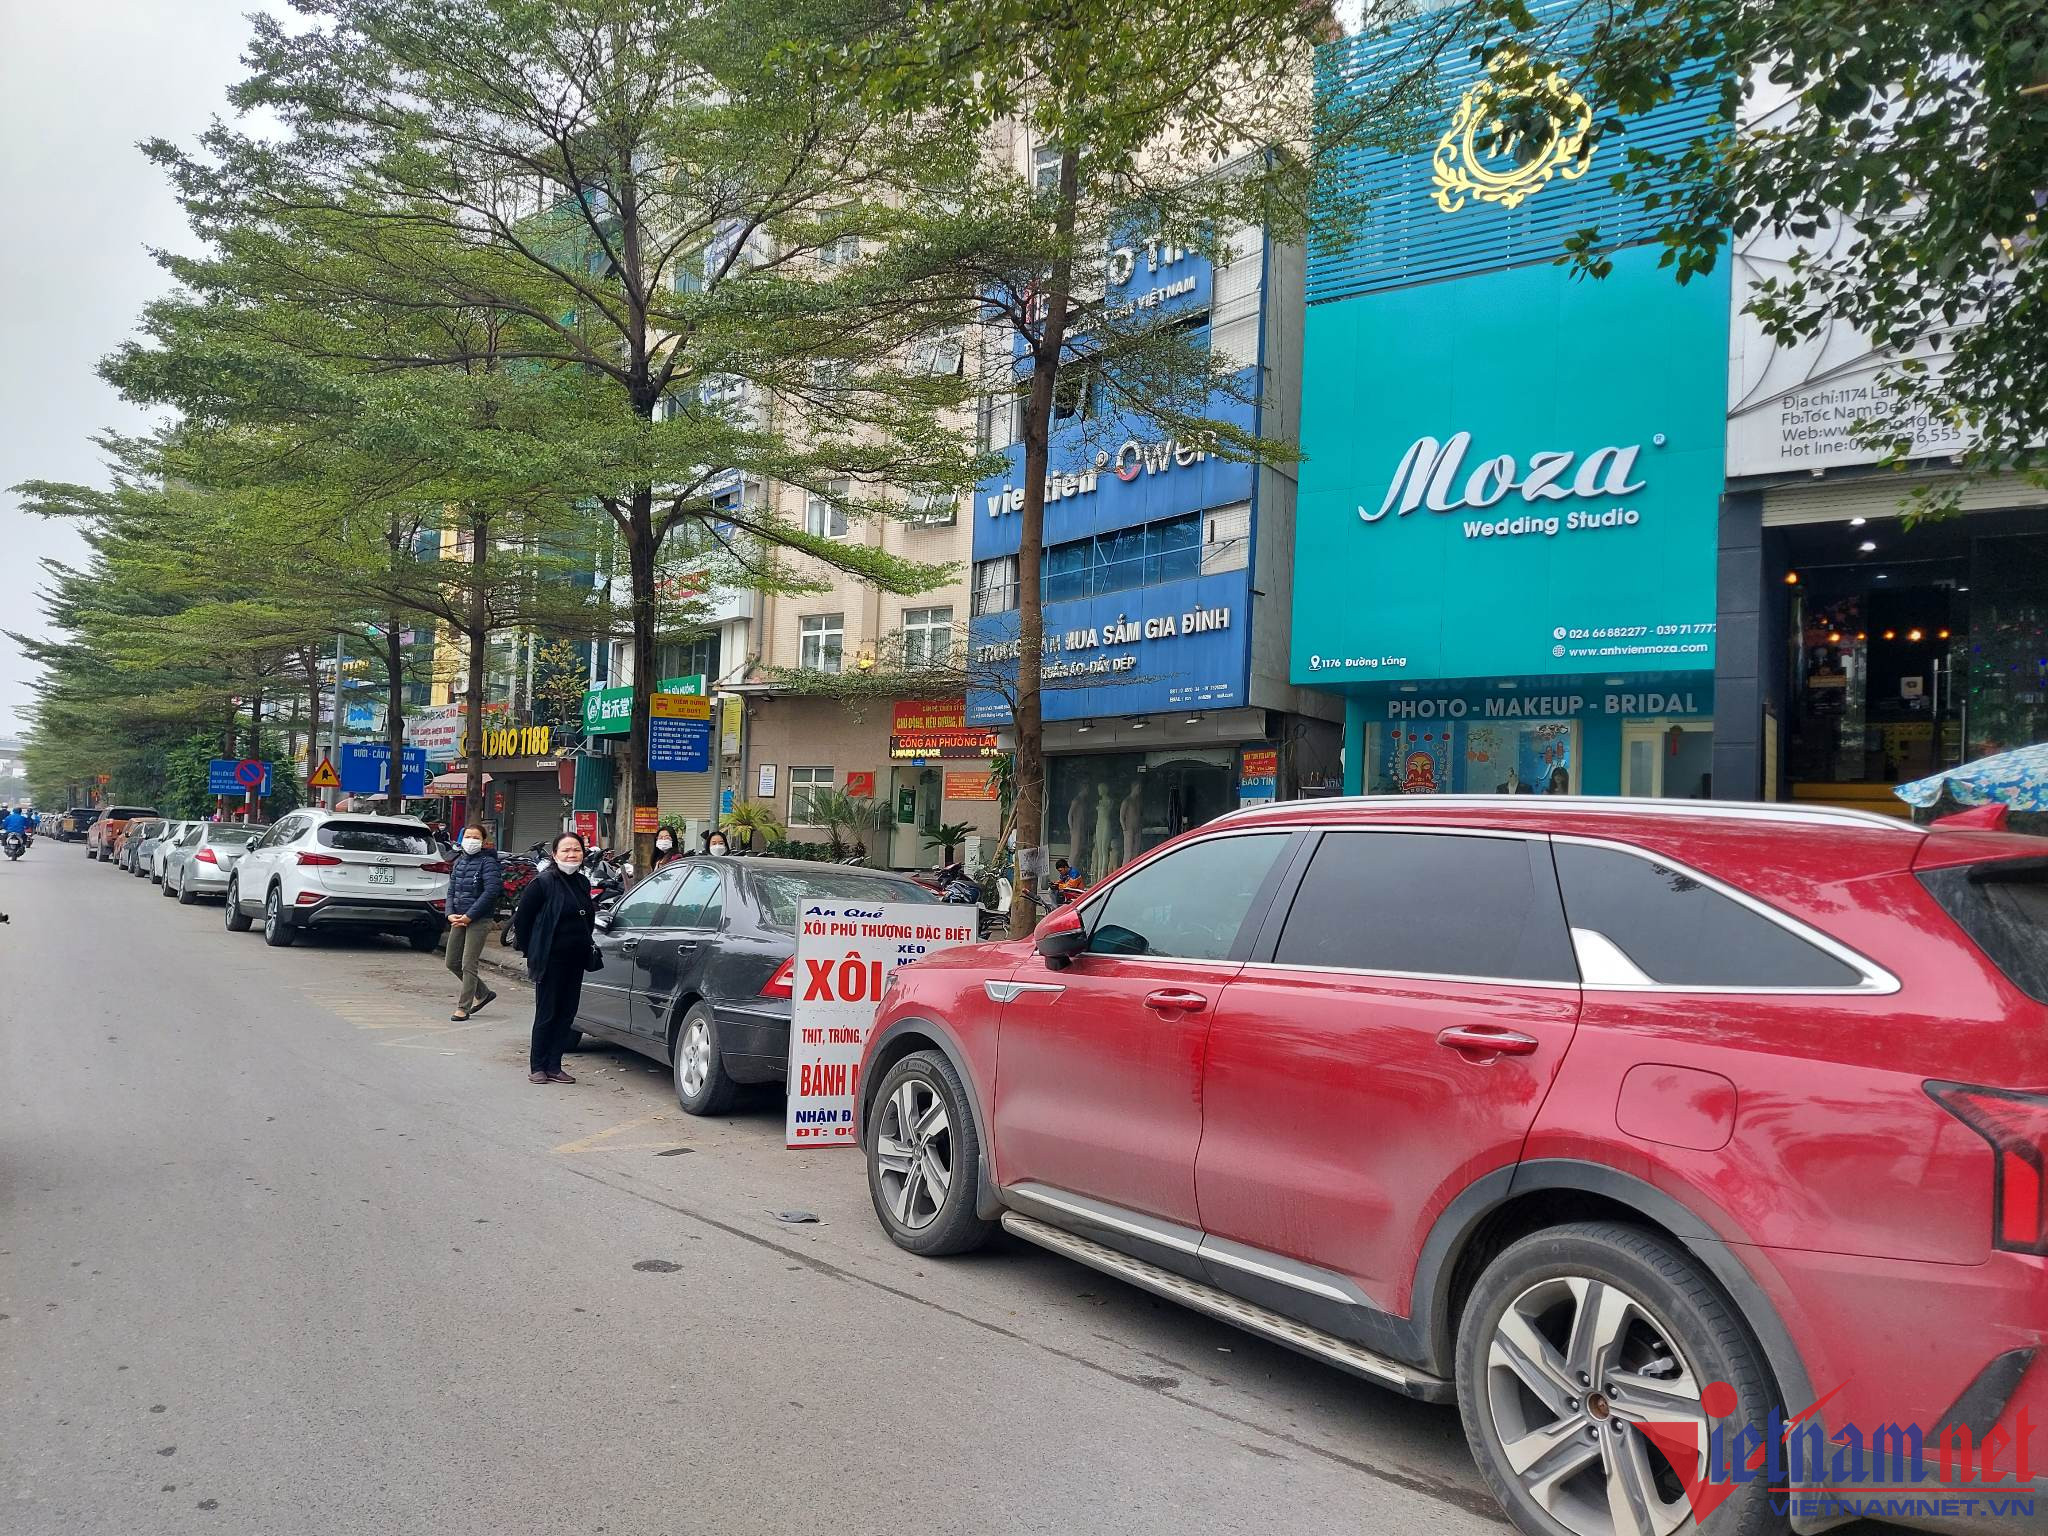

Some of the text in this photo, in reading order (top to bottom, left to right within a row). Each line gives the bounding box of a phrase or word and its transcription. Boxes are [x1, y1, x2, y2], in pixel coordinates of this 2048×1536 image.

[1835, 405, 1872, 420] Nam
[1781, 443, 1810, 457] Hot
[1358, 431, 1647, 521] Moza
[1464, 507, 1640, 538] Wedding Studio
[1065, 628, 1101, 651] MUA
[1103, 613, 1142, 645] SẮM
[1145, 616, 1177, 639] GIA
[1182, 605, 1231, 635] ĐÌNH
[1569, 629, 1590, 639] 024
[1656, 625, 1678, 635] 039
[1569, 642, 1708, 657] www.anhvienmoza.com
[1112, 652, 1138, 671] DÉP
[1321, 655, 1407, 668] 1176 Đường Láng
[601, 697, 633, 719] 益禾堂
[1388, 693, 1698, 719] PHOTO MAKEUP BRIDAL
[520, 725, 549, 756] 1188
[899, 736, 923, 748] CÔNG
[924, 738, 937, 748] AN
[939, 736, 977, 748] PHƯỜNG
[805, 906, 885, 919] An Quế
[803, 919, 972, 943] XÔI PHÚ THƯỢNG ĐẶC BIỆT
[803, 951, 883, 1002] XÔI
[802, 1028, 825, 1046] THỊT,
[800, 1057, 847, 1096] BÁNH
[795, 1108, 838, 1125] NHẬN
[795, 1128, 828, 1137] ĐT:
